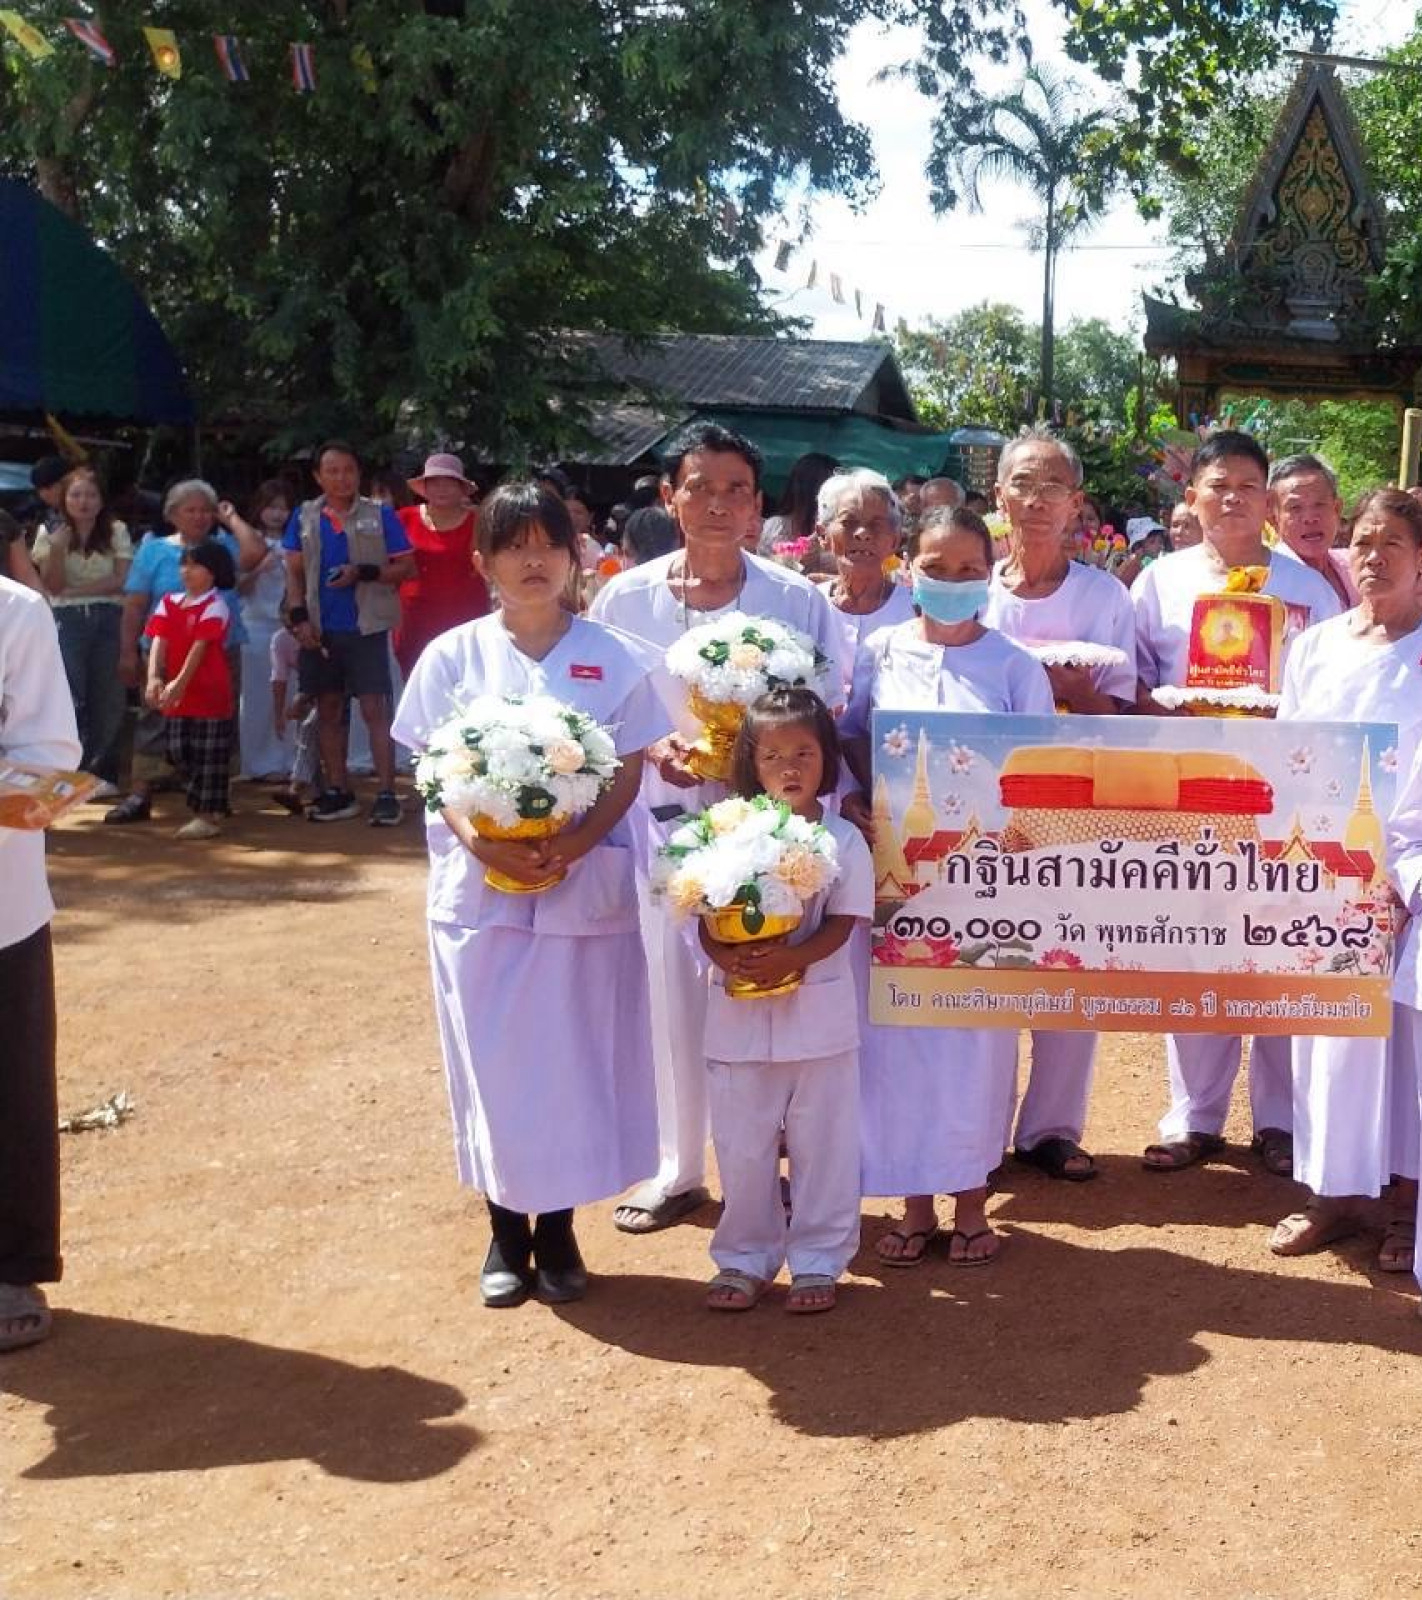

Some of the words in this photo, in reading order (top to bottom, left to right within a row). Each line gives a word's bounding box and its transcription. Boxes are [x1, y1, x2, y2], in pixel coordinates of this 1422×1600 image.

[946, 829, 1321, 898] กฐินสามัคคีทั่วไทย
[893, 916, 1043, 946] ๓๐,๐๐๐
[1054, 912, 1087, 943] วัด
[1096, 914, 1228, 952] พุทธศักราช
[1242, 914, 1374, 949] ๒๕๖๘
[887, 983, 921, 1008] โดย
[1200, 989, 1218, 1018] ปี
